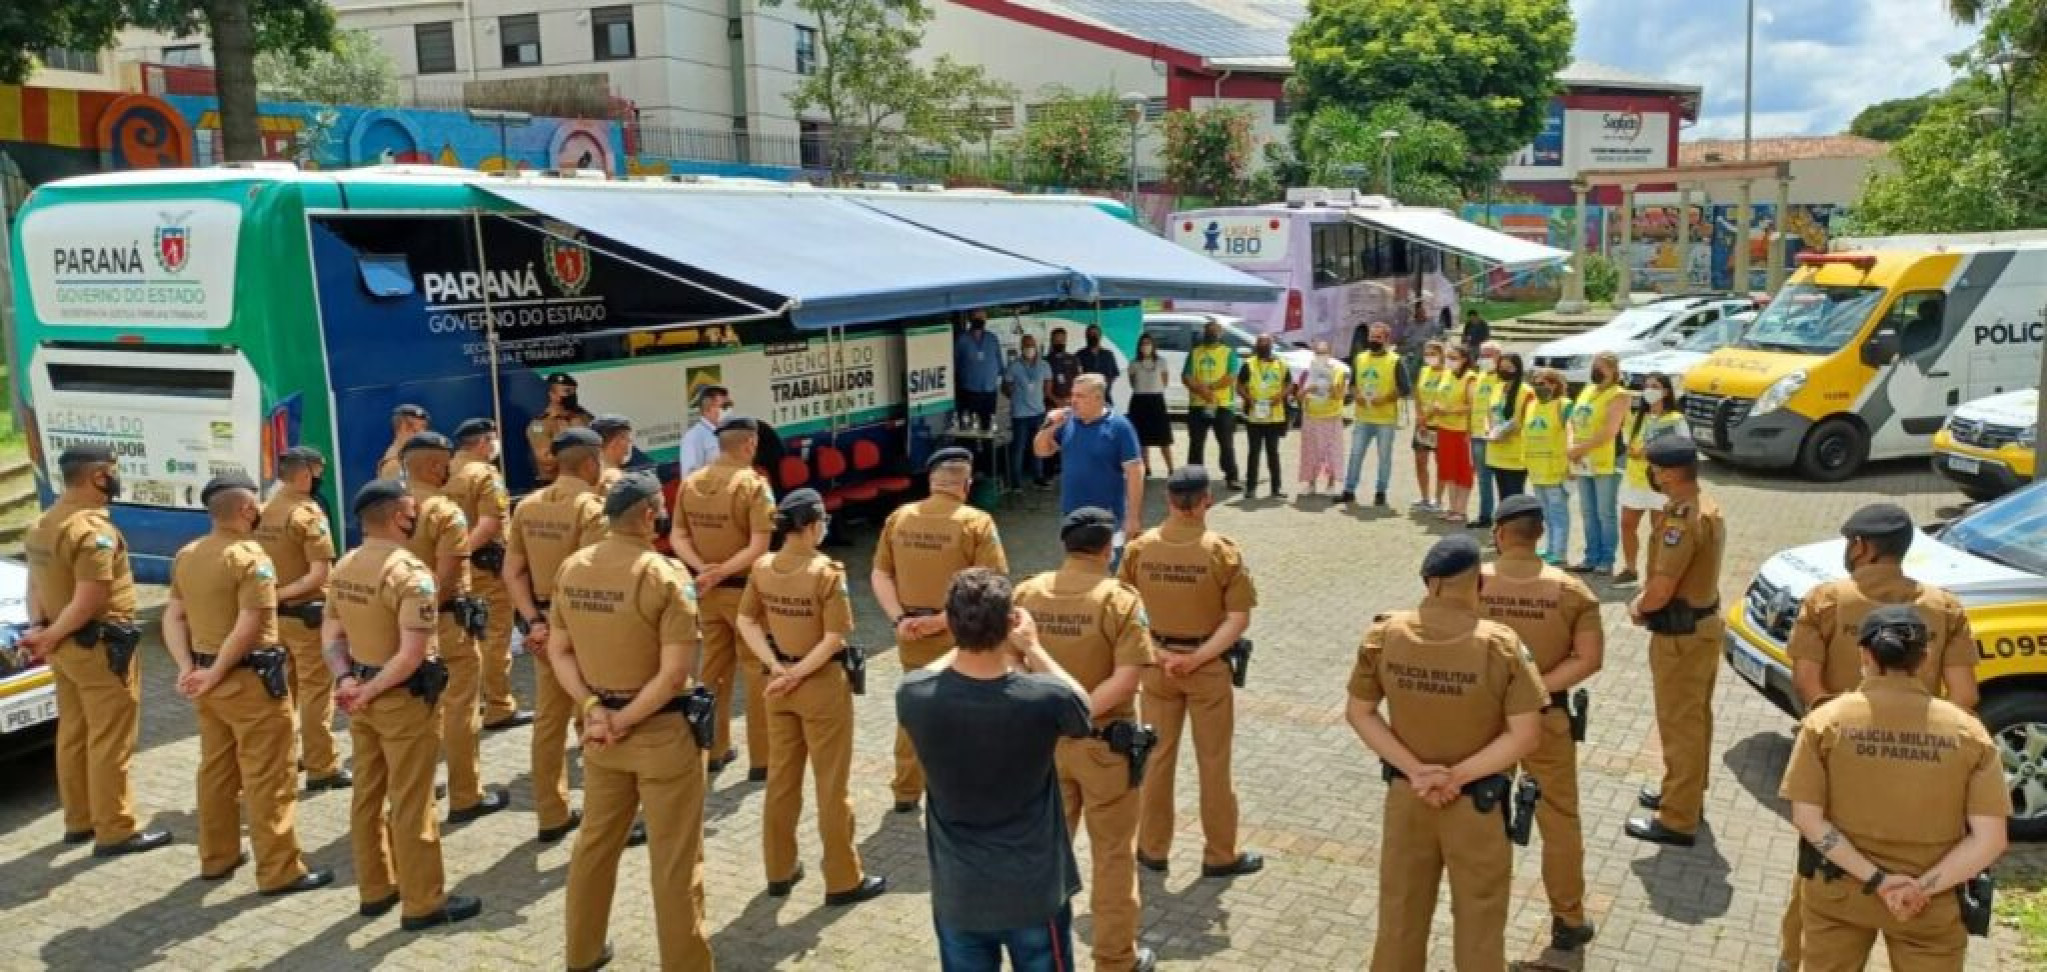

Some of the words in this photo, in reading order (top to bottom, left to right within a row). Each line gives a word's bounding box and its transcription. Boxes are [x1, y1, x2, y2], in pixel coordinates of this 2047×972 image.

[54, 240, 145, 275] PARANÁ
[1225, 238, 1261, 254] 180
[423, 262, 542, 302] PARANÁ
[57, 287, 120, 304] GOVERNO
[125, 287, 145, 303] DO
[148, 287, 206, 305] ESTADO
[519, 309, 542, 326] DO
[547, 304, 606, 323] ESTADO
[908, 365, 947, 394] SINE
